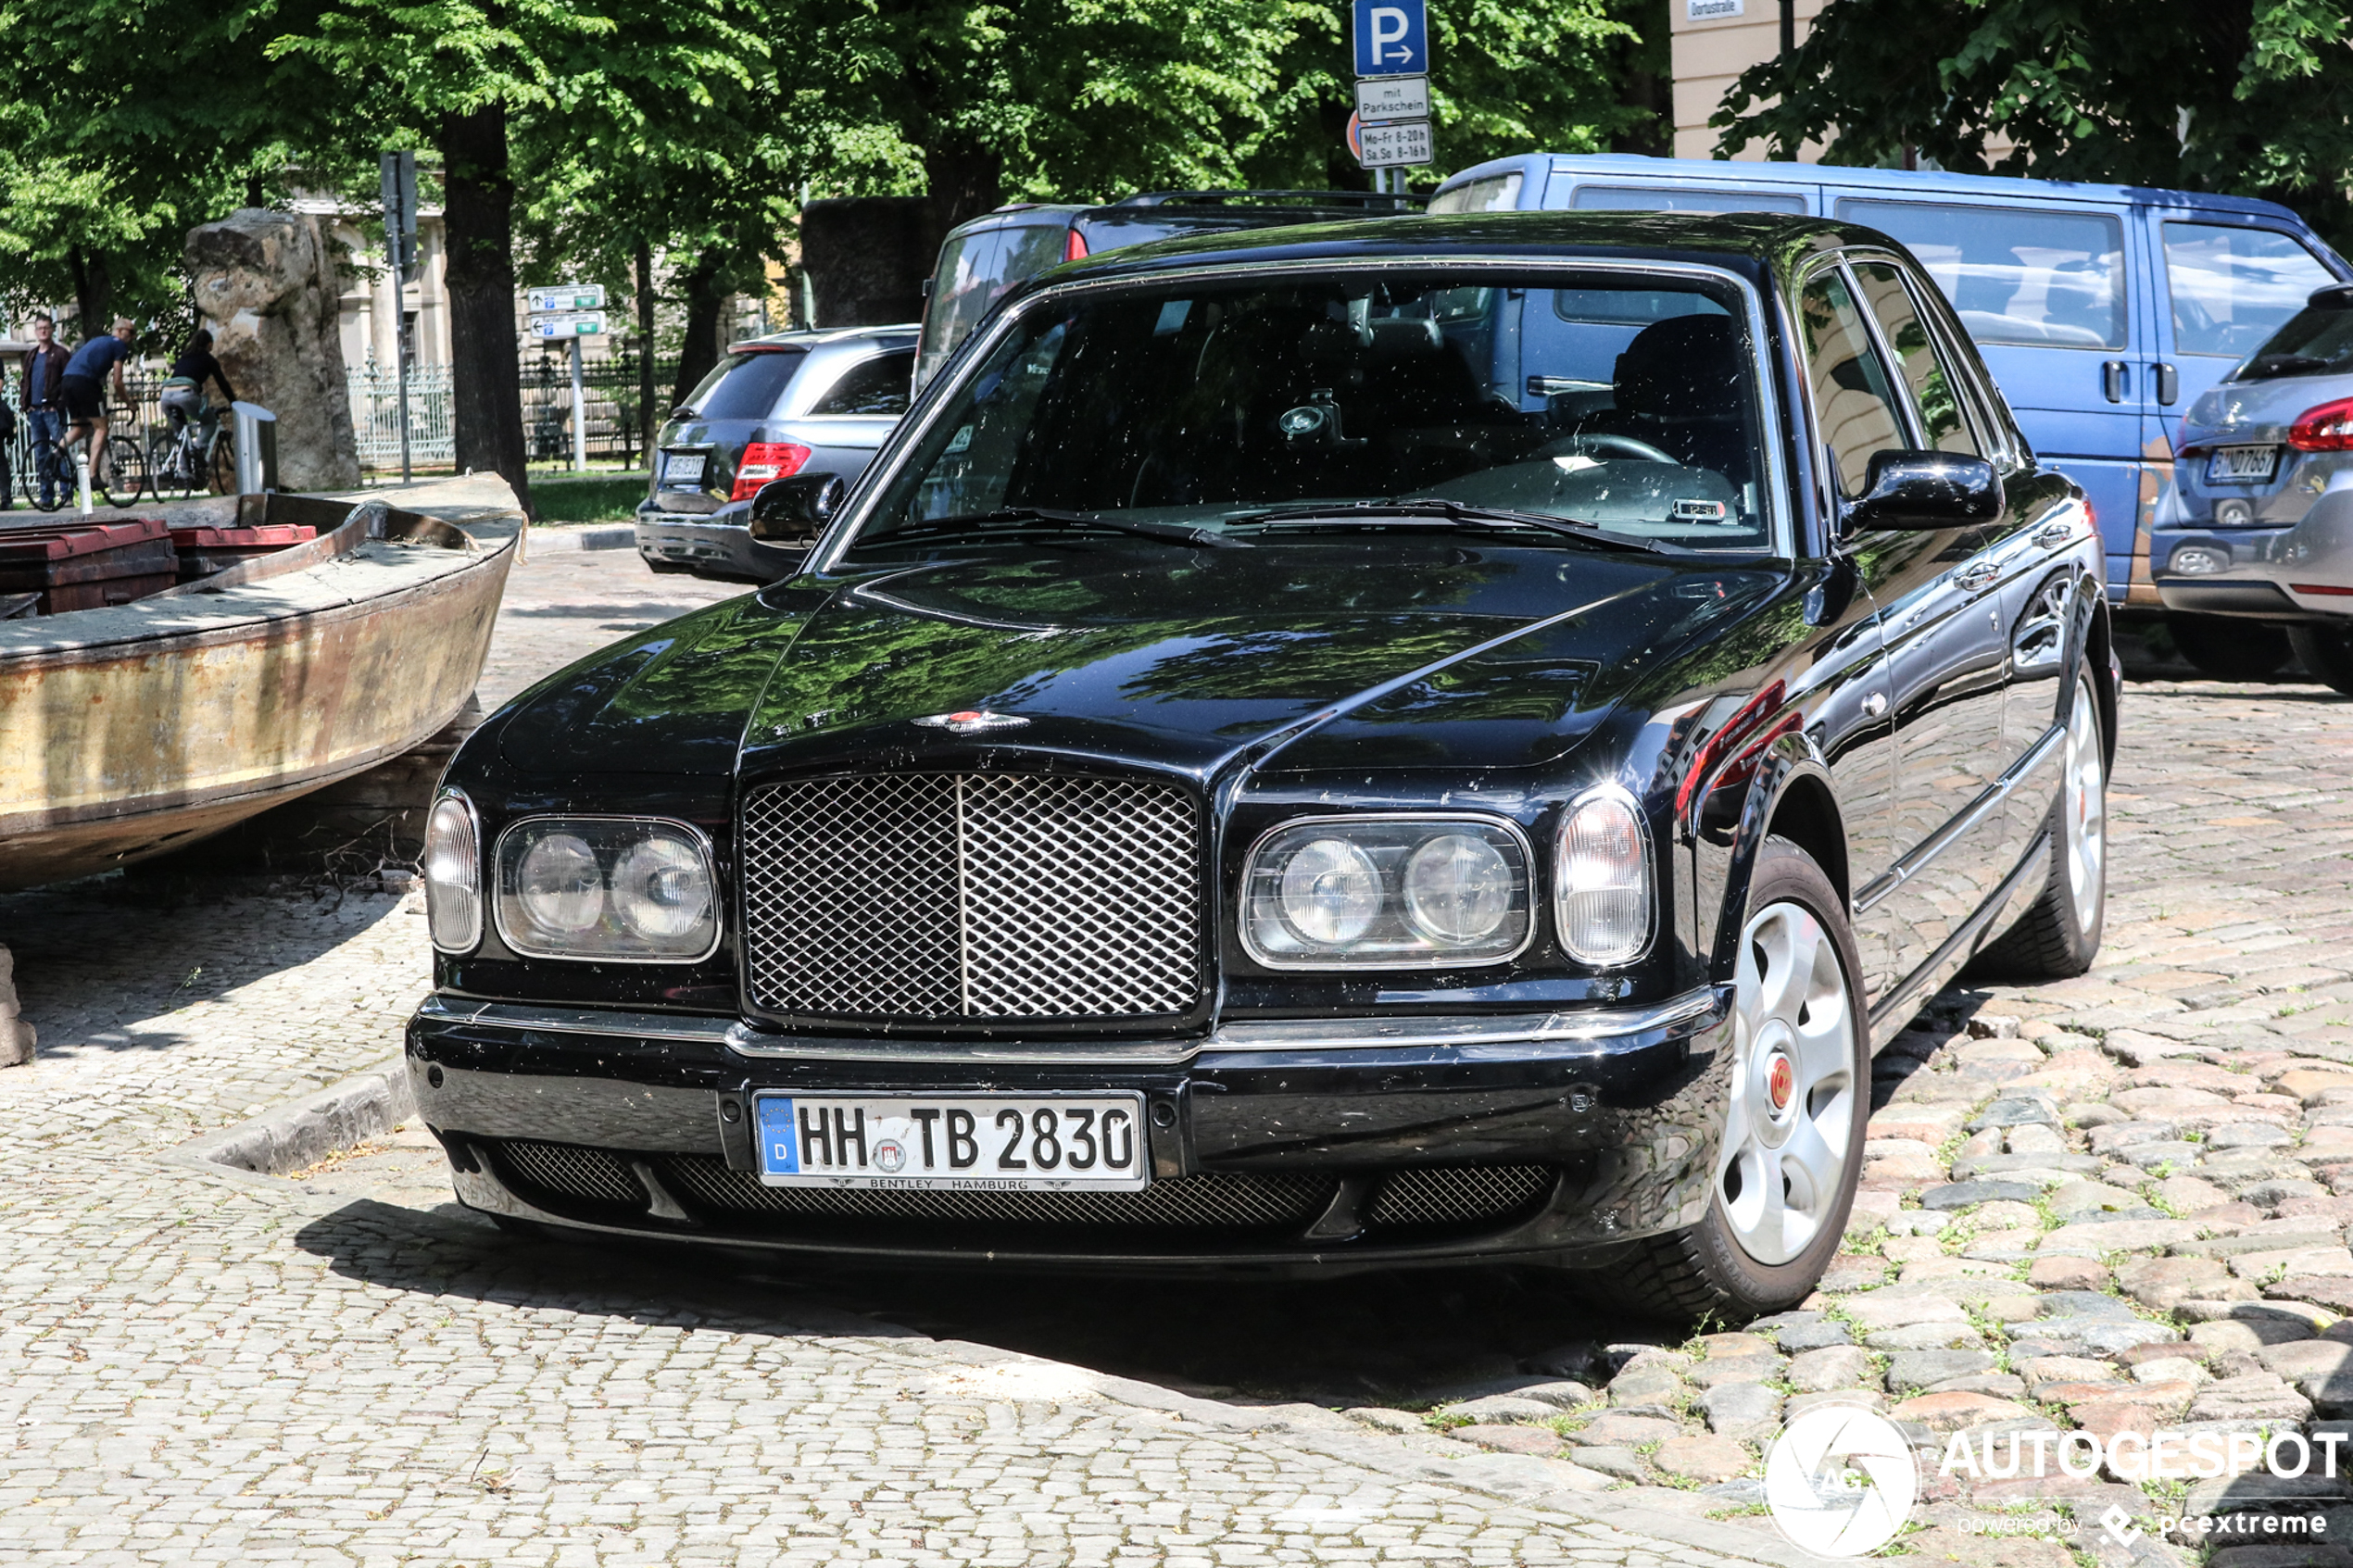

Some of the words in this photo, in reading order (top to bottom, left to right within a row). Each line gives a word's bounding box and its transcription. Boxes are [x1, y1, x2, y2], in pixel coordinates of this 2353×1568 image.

[1371, 7, 1408, 65] P
[1383, 88, 1402, 98] mit
[1363, 99, 1424, 114] Parkschein
[1365, 132, 1392, 145] Mo-Fr
[2214, 451, 2224, 474] B
[774, 1144, 787, 1160] D
[799, 1108, 868, 1166] HH
[911, 1109, 978, 1169] TB
[995, 1108, 1133, 1171] 2830
[870, 1179, 933, 1189] BENTLEY
[952, 1180, 1028, 1190] HAMBURG
